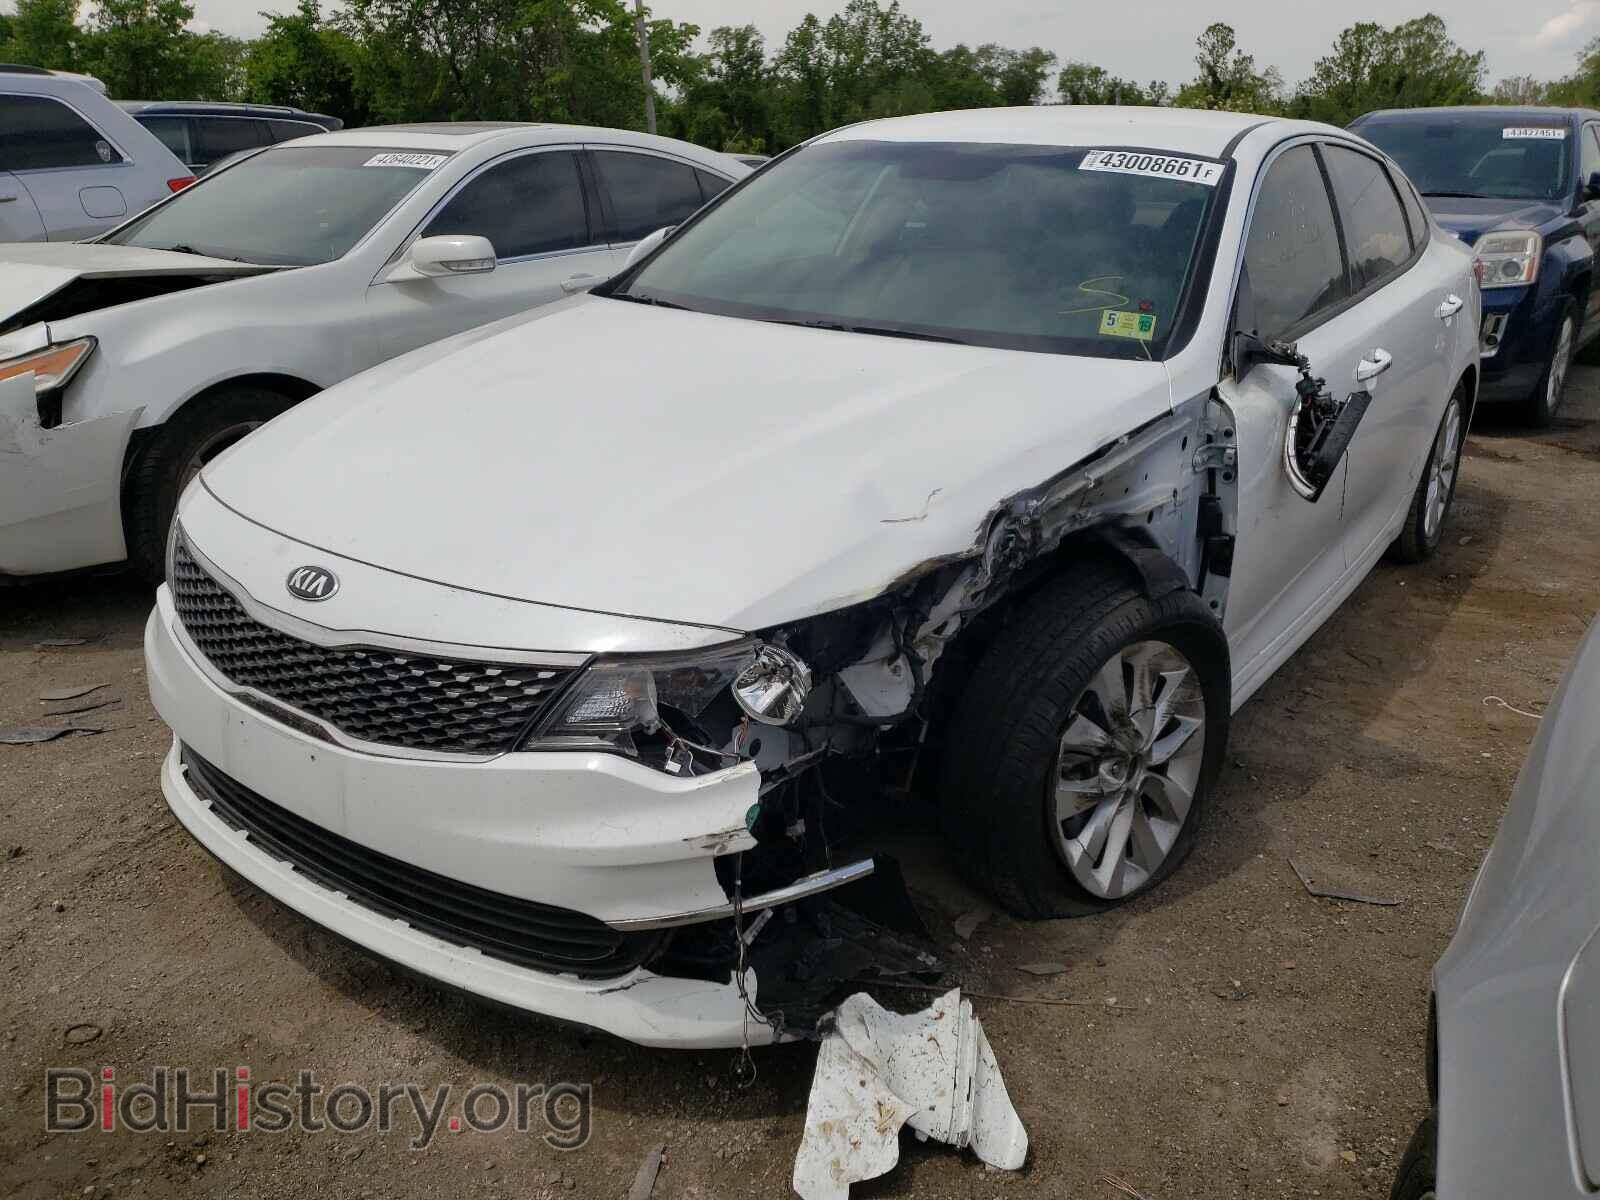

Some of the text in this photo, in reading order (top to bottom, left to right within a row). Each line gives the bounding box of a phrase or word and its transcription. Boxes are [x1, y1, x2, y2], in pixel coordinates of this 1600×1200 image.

[1099, 152, 1204, 178] 43008661
[1203, 169, 1214, 179] F
[1106, 312, 1118, 326] 5
[288, 568, 329, 596] KIA
